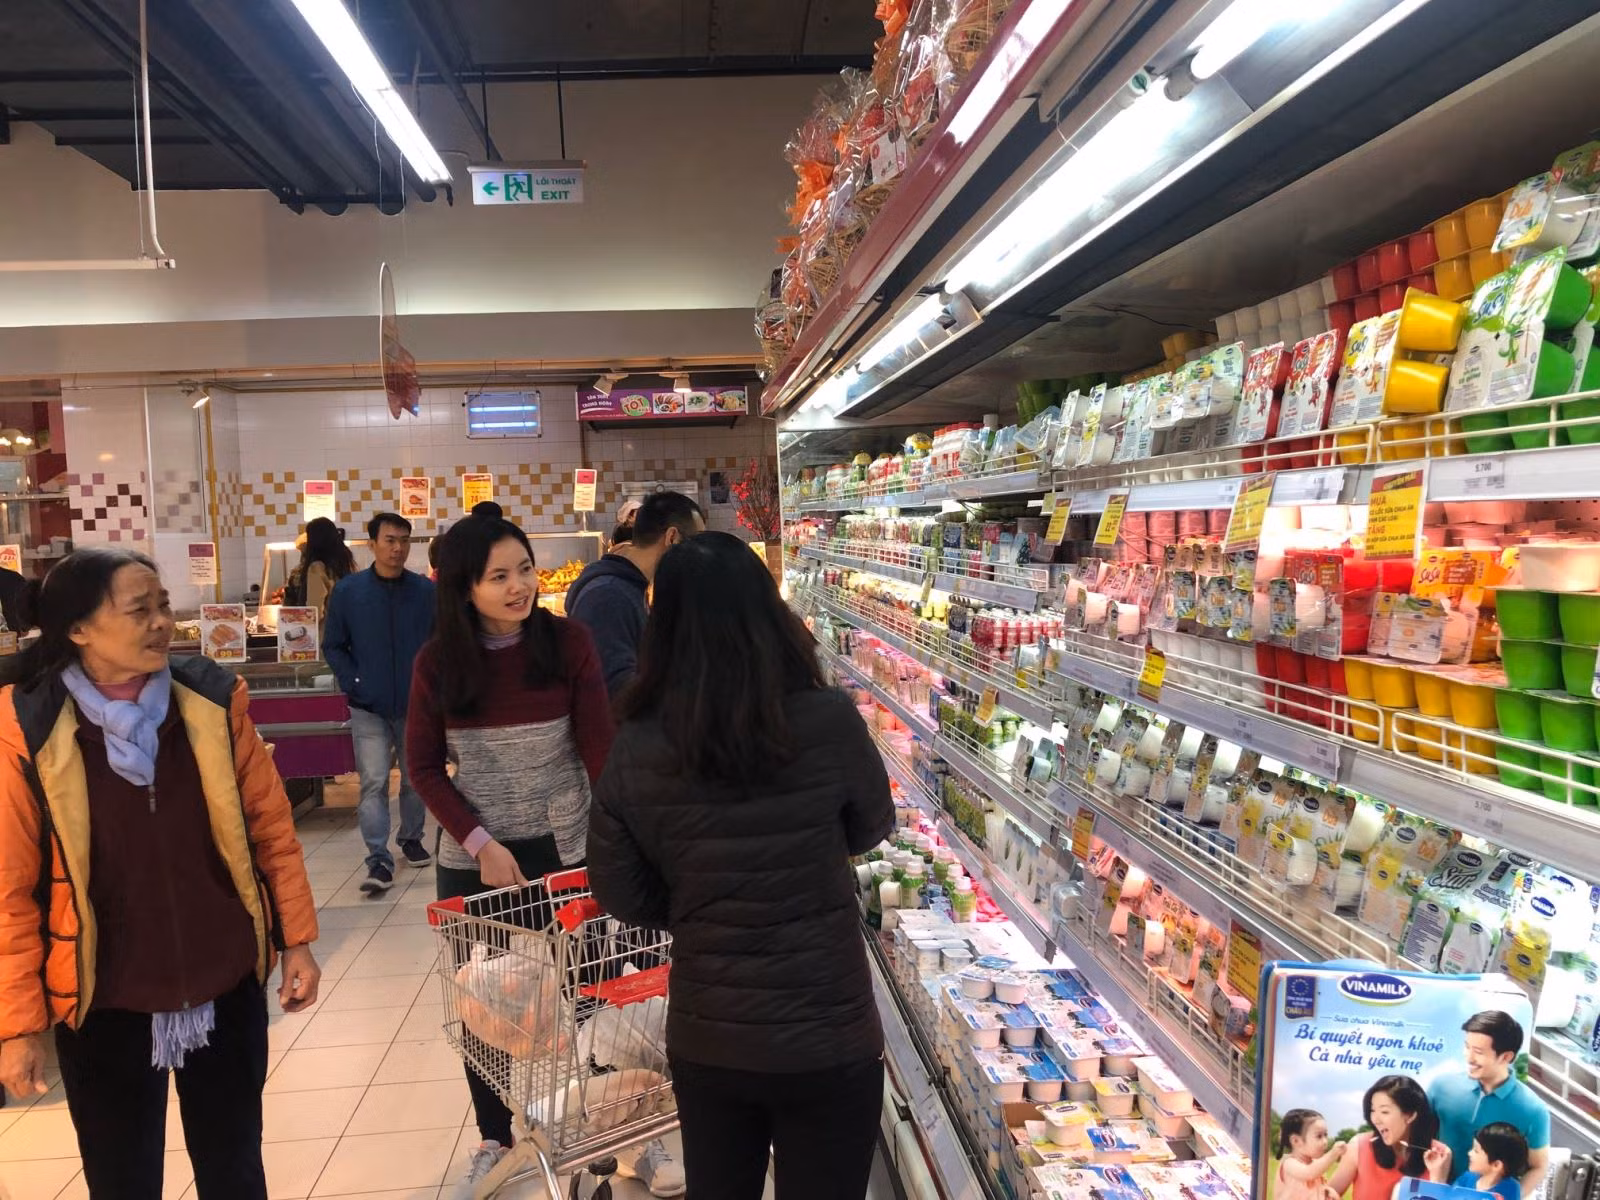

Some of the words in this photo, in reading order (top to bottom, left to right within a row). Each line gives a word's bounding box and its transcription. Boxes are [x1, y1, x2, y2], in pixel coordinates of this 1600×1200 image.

[541, 190, 570, 200] EXIT
[1371, 496, 1386, 506] MUA
[1345, 980, 1408, 996] VINAMILK
[1319, 1028, 1362, 1047] quyết
[1366, 1036, 1404, 1050] ngon
[1335, 1050, 1363, 1065] nhà
[1368, 1055, 1396, 1070] yêu
[1400, 1060, 1423, 1075] mẹ
